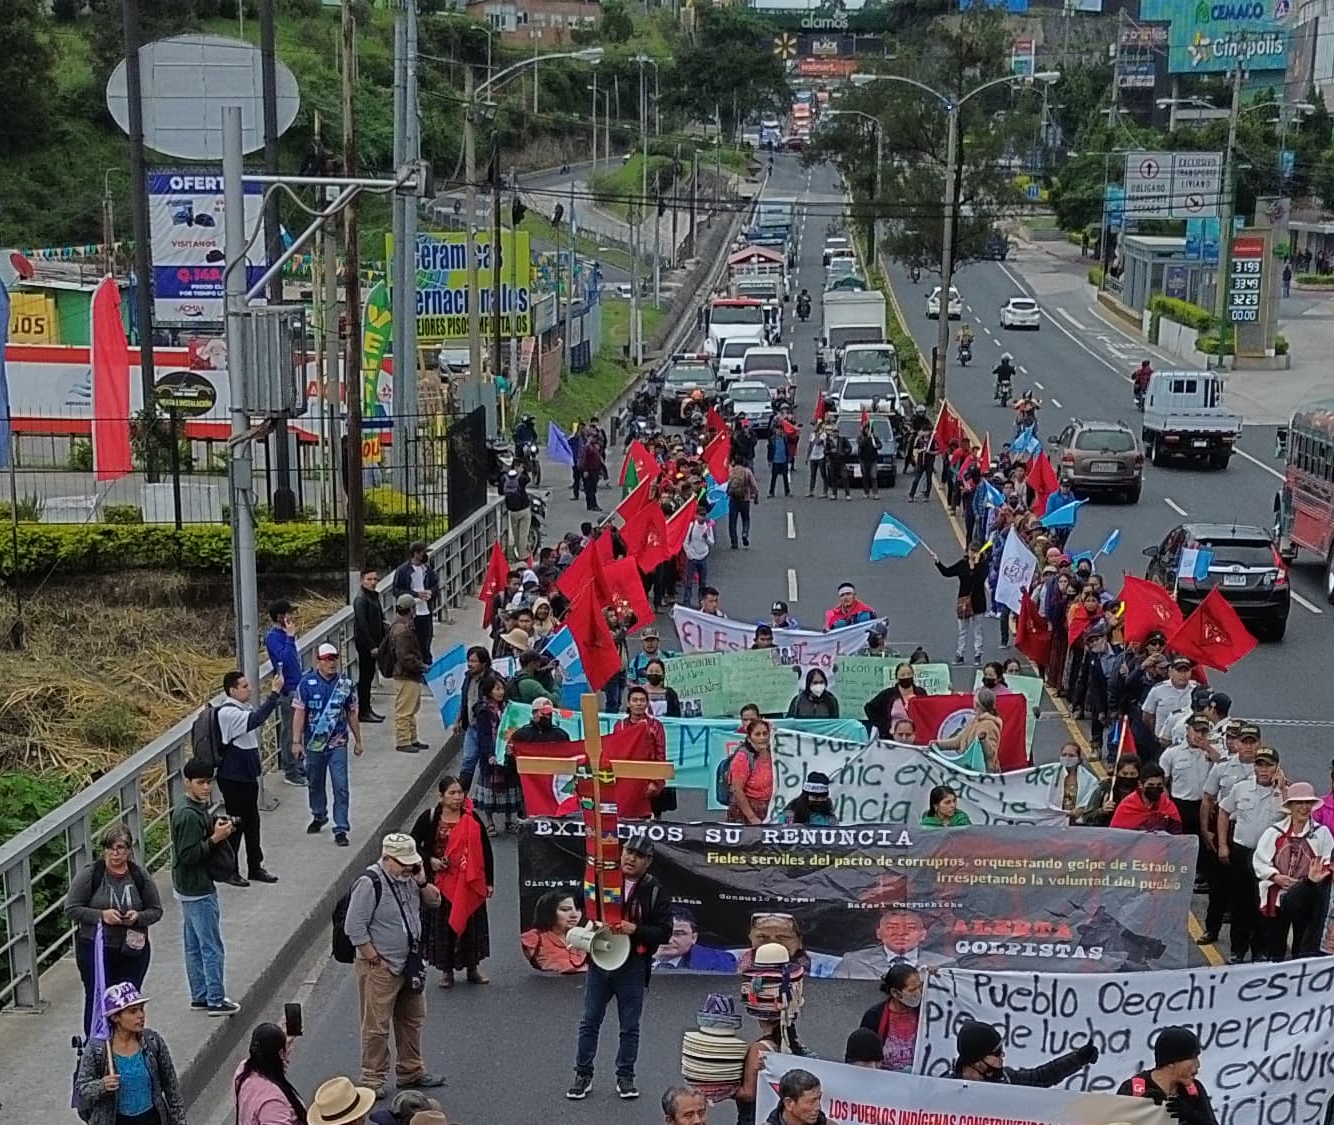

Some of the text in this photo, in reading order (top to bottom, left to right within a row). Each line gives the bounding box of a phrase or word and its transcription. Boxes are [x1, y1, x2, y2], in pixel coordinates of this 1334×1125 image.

[1211, 2, 1264, 20] CEMACO
[682, 620, 702, 650] El
[534, 819, 913, 846] EXIIMOS SU RENUNCIA
[707, 852, 747, 865] Fieles
[752, 853, 805, 866] serviles
[809, 854, 831, 867] del
[834, 855, 873, 870] pacto
[876, 855, 894, 867] de
[974, 857, 1063, 871] orquestando
[1068, 858, 1106, 872] golpe
[1110, 859, 1128, 871] de
[1132, 860, 1175, 874] Estado
[936, 871, 1027, 886] irrespetando
[1031, 872, 1044, 886] la
[1048, 873, 1110, 888] voluntad
[1114, 875, 1136, 889] del
[951, 919, 1073, 937] ALERTA
[955, 940, 1104, 960] GOLPISTAS
[974, 974, 1078, 1019] Pueblo
[1041, 1017, 1132, 1055] lucha
[829, 1098, 848, 1121] LOS
